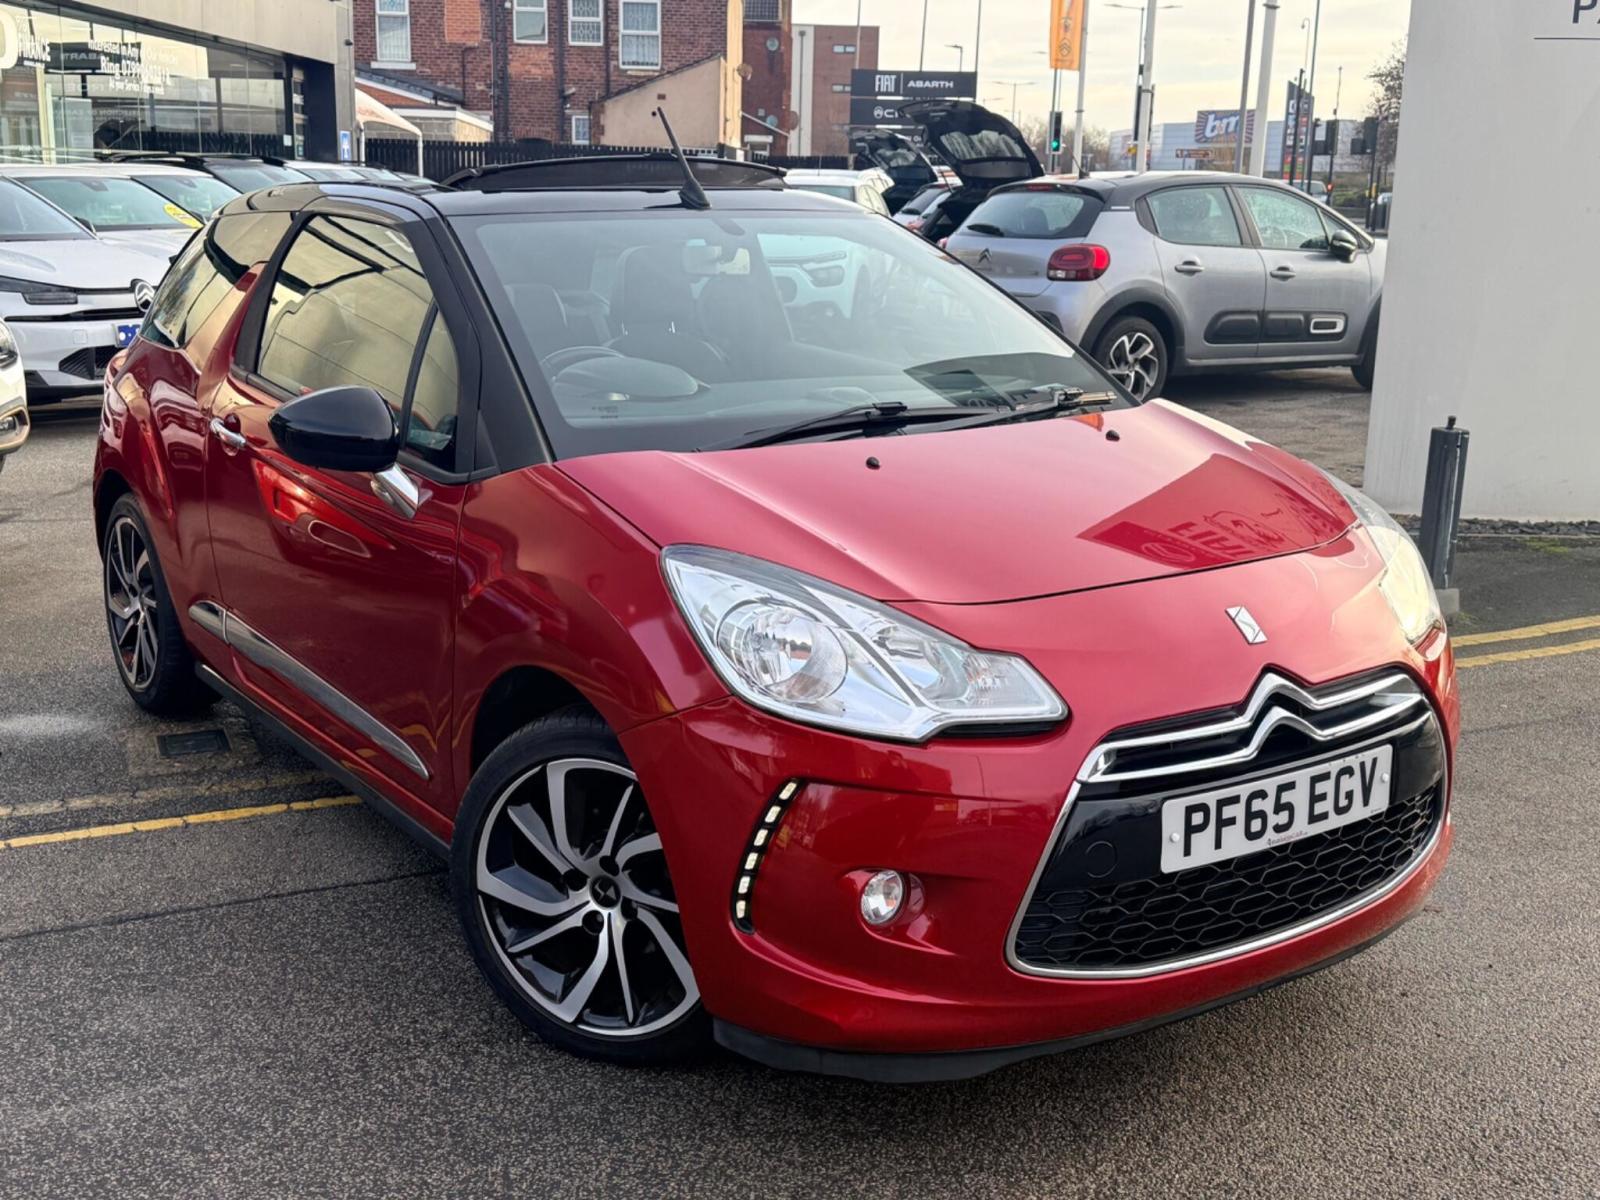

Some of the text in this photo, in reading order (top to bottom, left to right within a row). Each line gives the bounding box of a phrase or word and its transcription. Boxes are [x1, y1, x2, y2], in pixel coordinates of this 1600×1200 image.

[1572, 0, 1600, 24] P
[875, 74, 896, 92] FIAT
[907, 80, 954, 88] ABARTH
[1183, 757, 1378, 857] PF65 EGV
